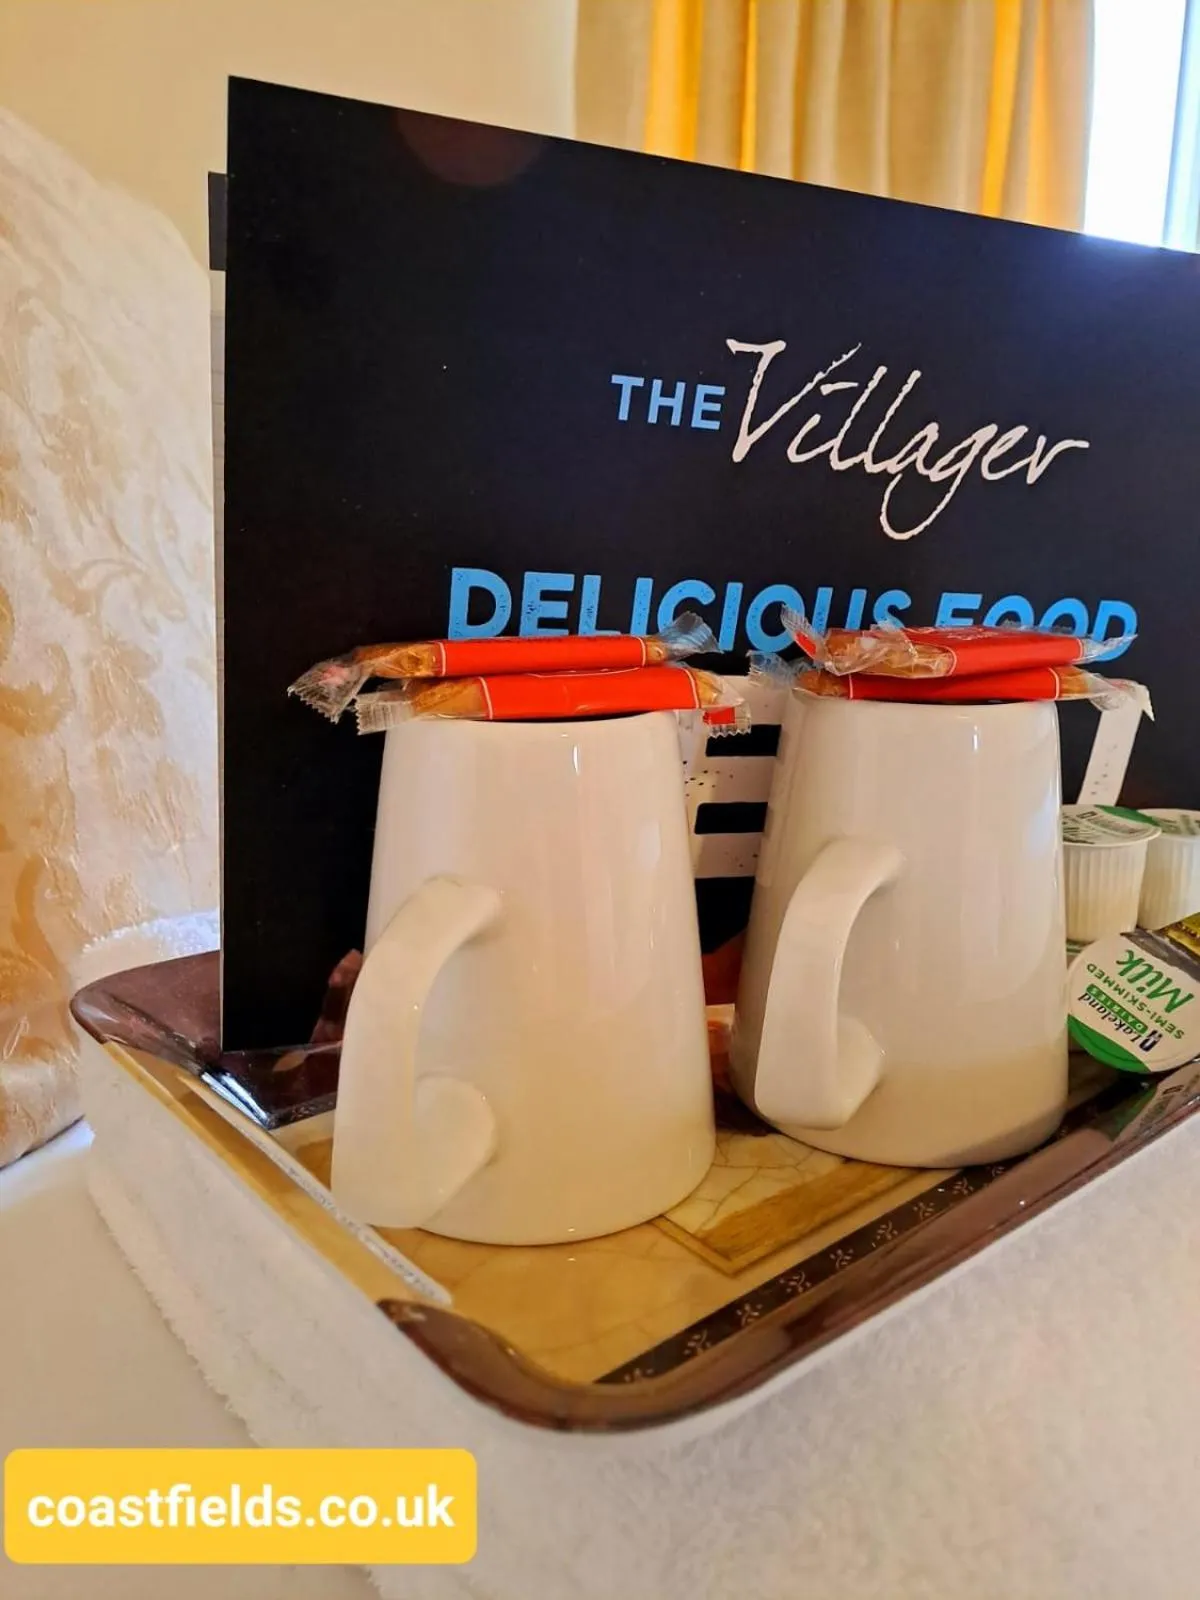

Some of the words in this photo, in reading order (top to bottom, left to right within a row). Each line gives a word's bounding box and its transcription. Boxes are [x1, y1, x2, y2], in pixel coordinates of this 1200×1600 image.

[611, 374, 726, 430] THE
[725, 338, 1090, 540] Villager
[448, 566, 912, 655] DELICIOUS
[1086, 963, 1185, 1040] SEMI-SKIMMED
[1088, 986, 1146, 1032] DAIRIES
[1115, 949, 1195, 1013] Milk
[1078, 992, 1143, 1043] Lakeland
